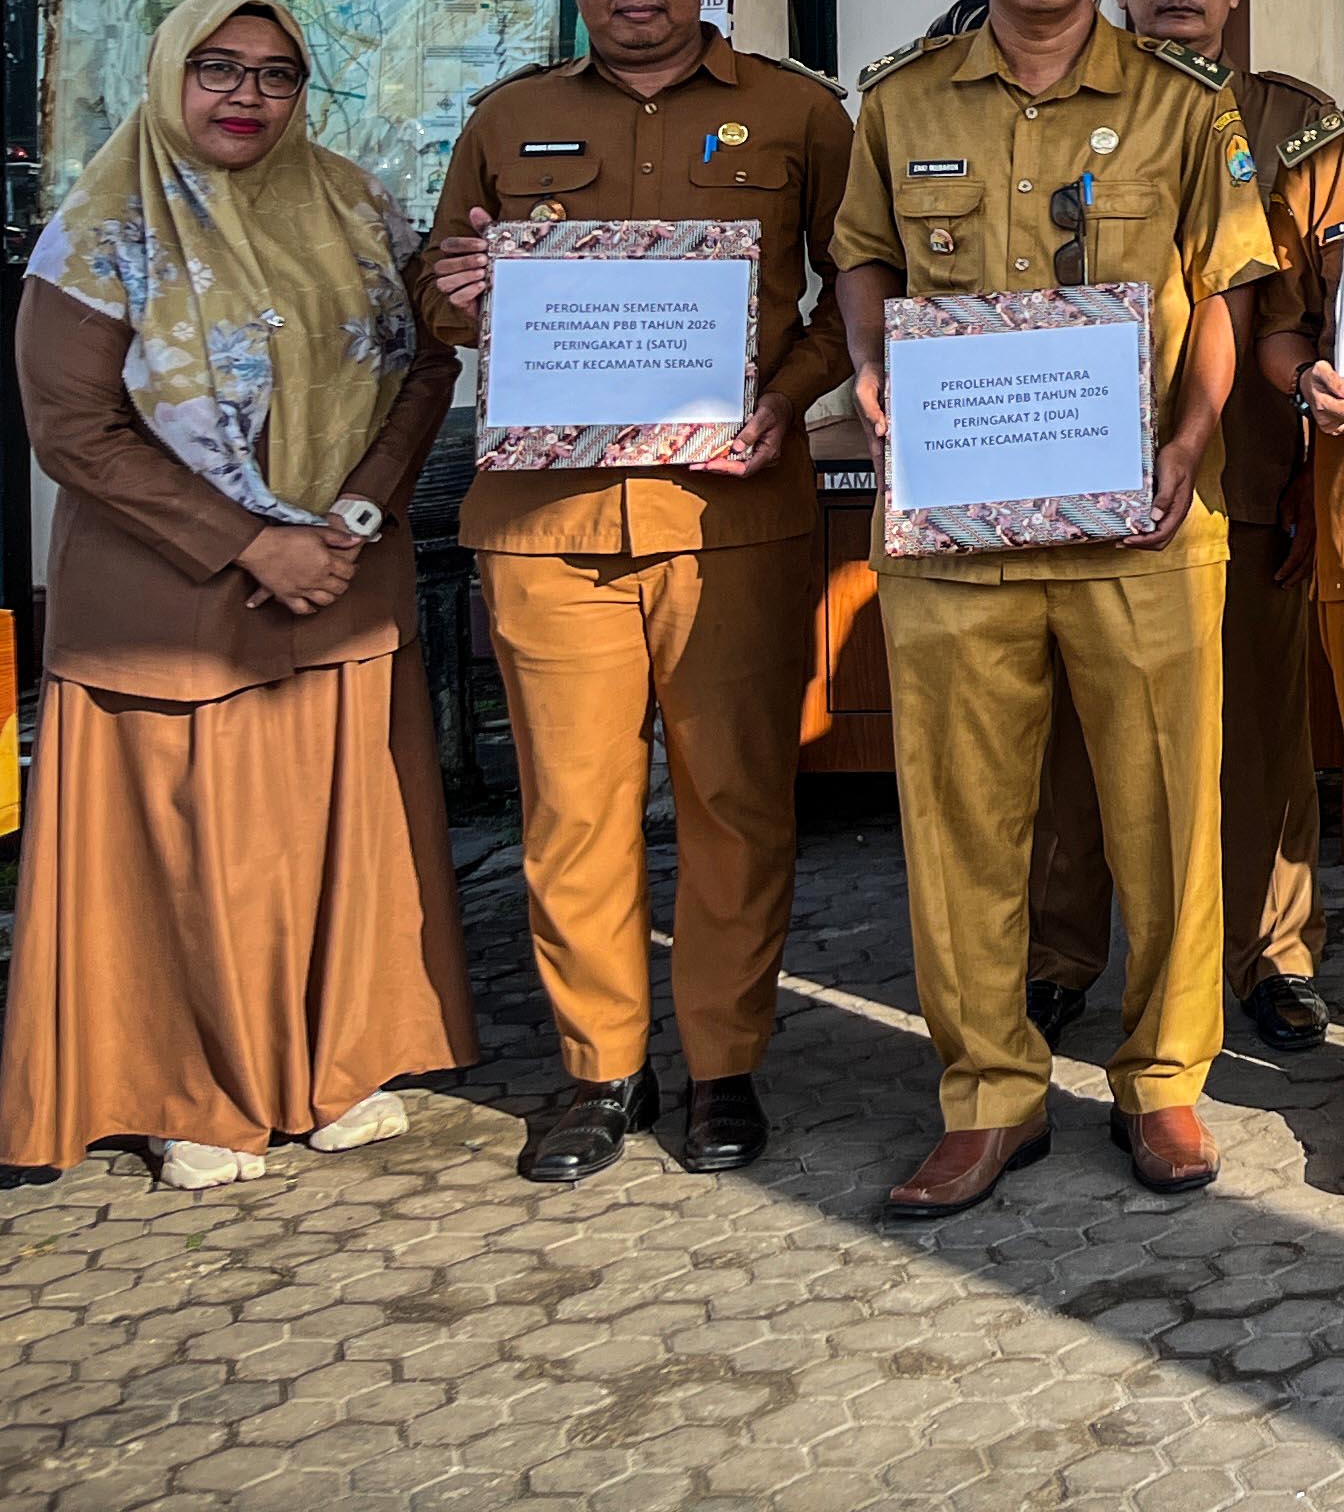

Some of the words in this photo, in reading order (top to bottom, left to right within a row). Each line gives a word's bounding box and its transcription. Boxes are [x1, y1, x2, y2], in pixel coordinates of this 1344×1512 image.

[545, 303, 620, 313] PEROLEHAN
[623, 302, 699, 313] SEMENTARA
[525, 320, 610, 331] PENERIMAAN
[613, 320, 638, 330] PBB
[640, 320, 684, 330] TAHUN
[687, 319, 717, 330] 2026
[553, 339, 633, 350] PERINGAKAT
[635, 340, 643, 350] 1
[646, 339, 688, 351] (SATU)
[524, 359, 580, 370] TINGKAT
[583, 359, 662, 370] KECAMATAN
[664, 358, 714, 369] SERANG
[941, 376, 1013, 391] PEROLEHAN
[1015, 370, 1090, 386] SEMENTARA
[922, 394, 1004, 411] PENERIMAAN
[1007, 392, 1031, 404] PBB
[1034, 389, 1077, 402] TAHUN
[1080, 386, 1109, 398] 2026
[953, 412, 1031, 428] PERINGAKAT
[1033, 411, 1041, 422] 2
[1044, 407, 1080, 423] (DUA)
[924, 436, 978, 451] TINGKAT
[980, 430, 1058, 446] KECAMATAN
[1060, 425, 1110, 440] SERANG
[825, 472, 872, 489] TAM
